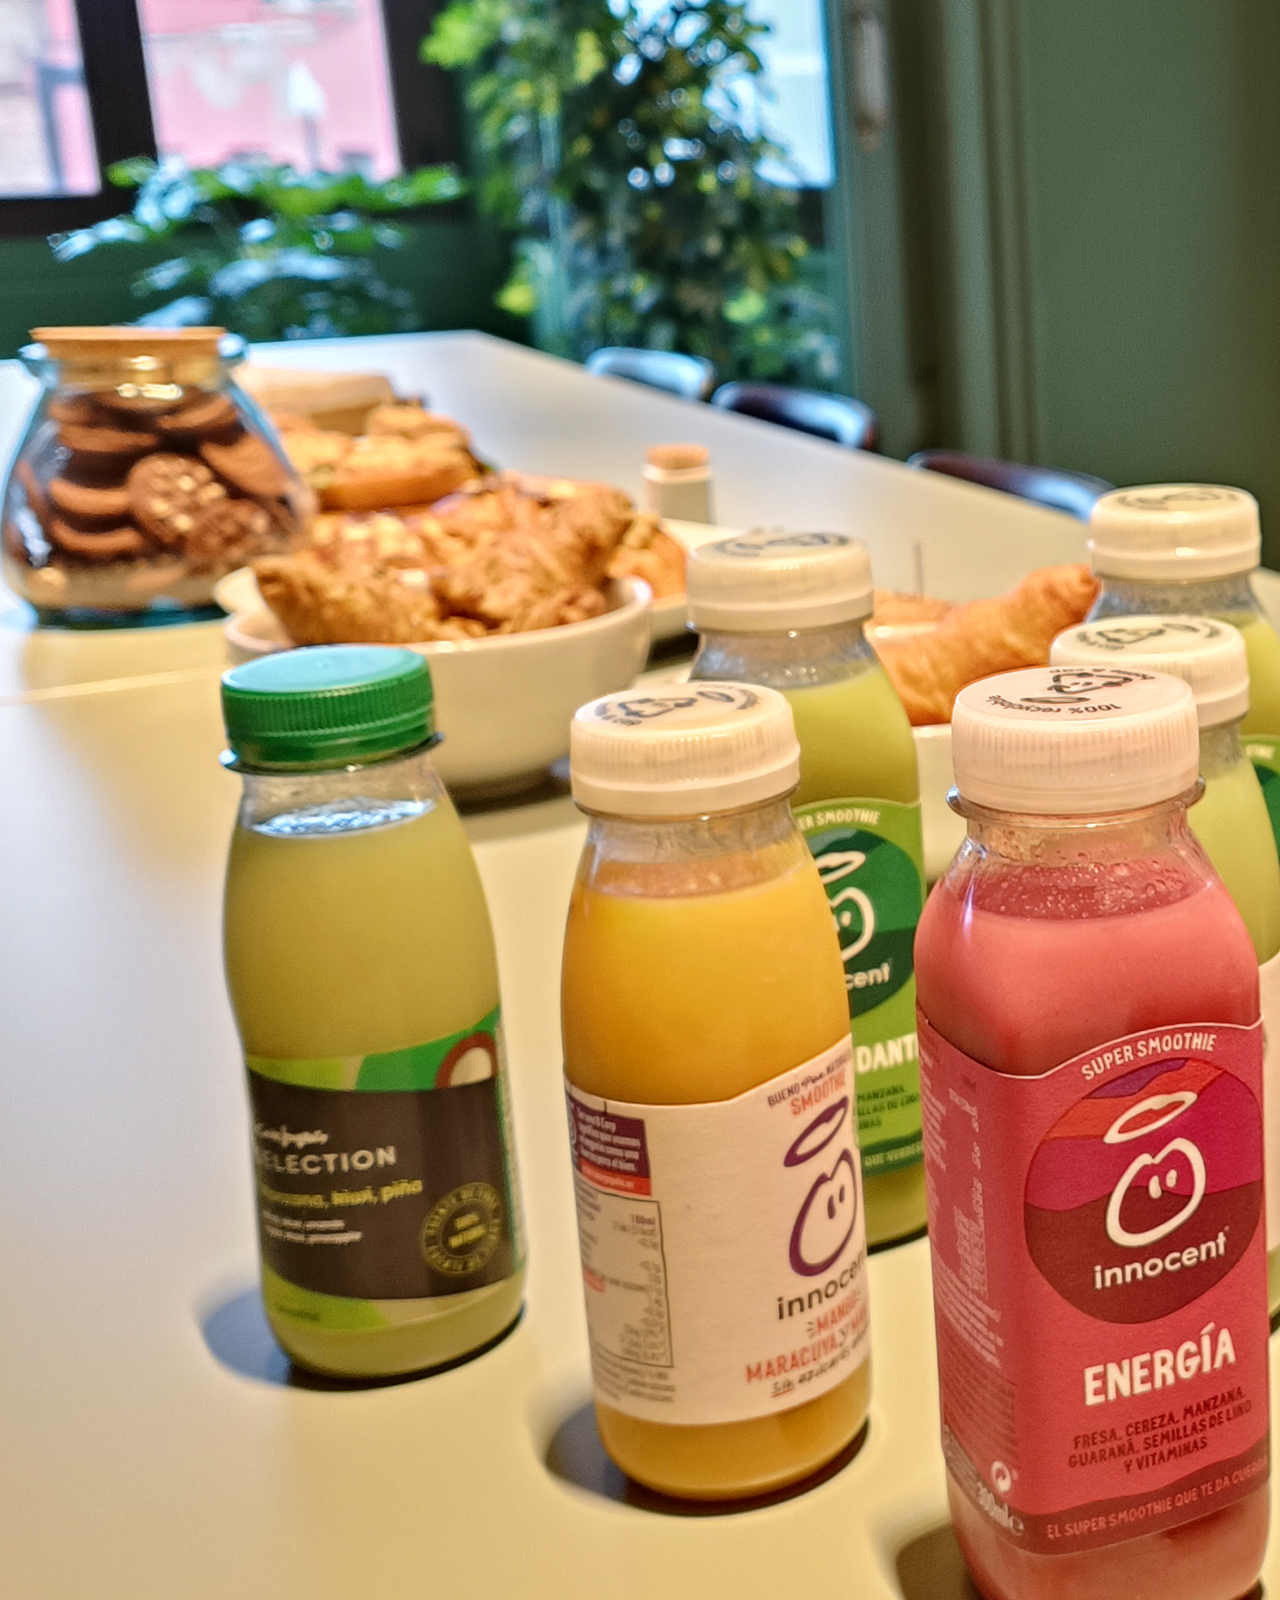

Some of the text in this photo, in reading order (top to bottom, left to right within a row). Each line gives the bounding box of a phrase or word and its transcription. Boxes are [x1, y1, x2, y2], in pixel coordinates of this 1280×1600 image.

[1068, 702, 1122, 714] 100%
[816, 807, 881, 827] SMOOTHIE
[856, 1031, 919, 1074] DANT
[1081, 1032, 1218, 1081] SUPER SMOOTHIE
[767, 1082, 801, 1108] BUENO
[258, 1145, 397, 1176] LECTION
[1093, 1231, 1227, 1291] innocent
[1084, 1321, 1237, 1406] ENERGÍA
[1143, 1419, 1208, 1451] SEMILLAS
[1208, 1411, 1224, 1430] DE
[1225, 1399, 1252, 1423] LINO
[1124, 1436, 1209, 1475] Y VITAMINAS
[1046, 1523, 1061, 1540] EL
[1064, 1515, 1106, 1537] SUPER
[1107, 1496, 1172, 1527] SMOOTHIE
[1175, 1487, 1199, 1508] QUE
[1199, 1482, 1214, 1498] TE
[1214, 1473, 1231, 1492] DA
